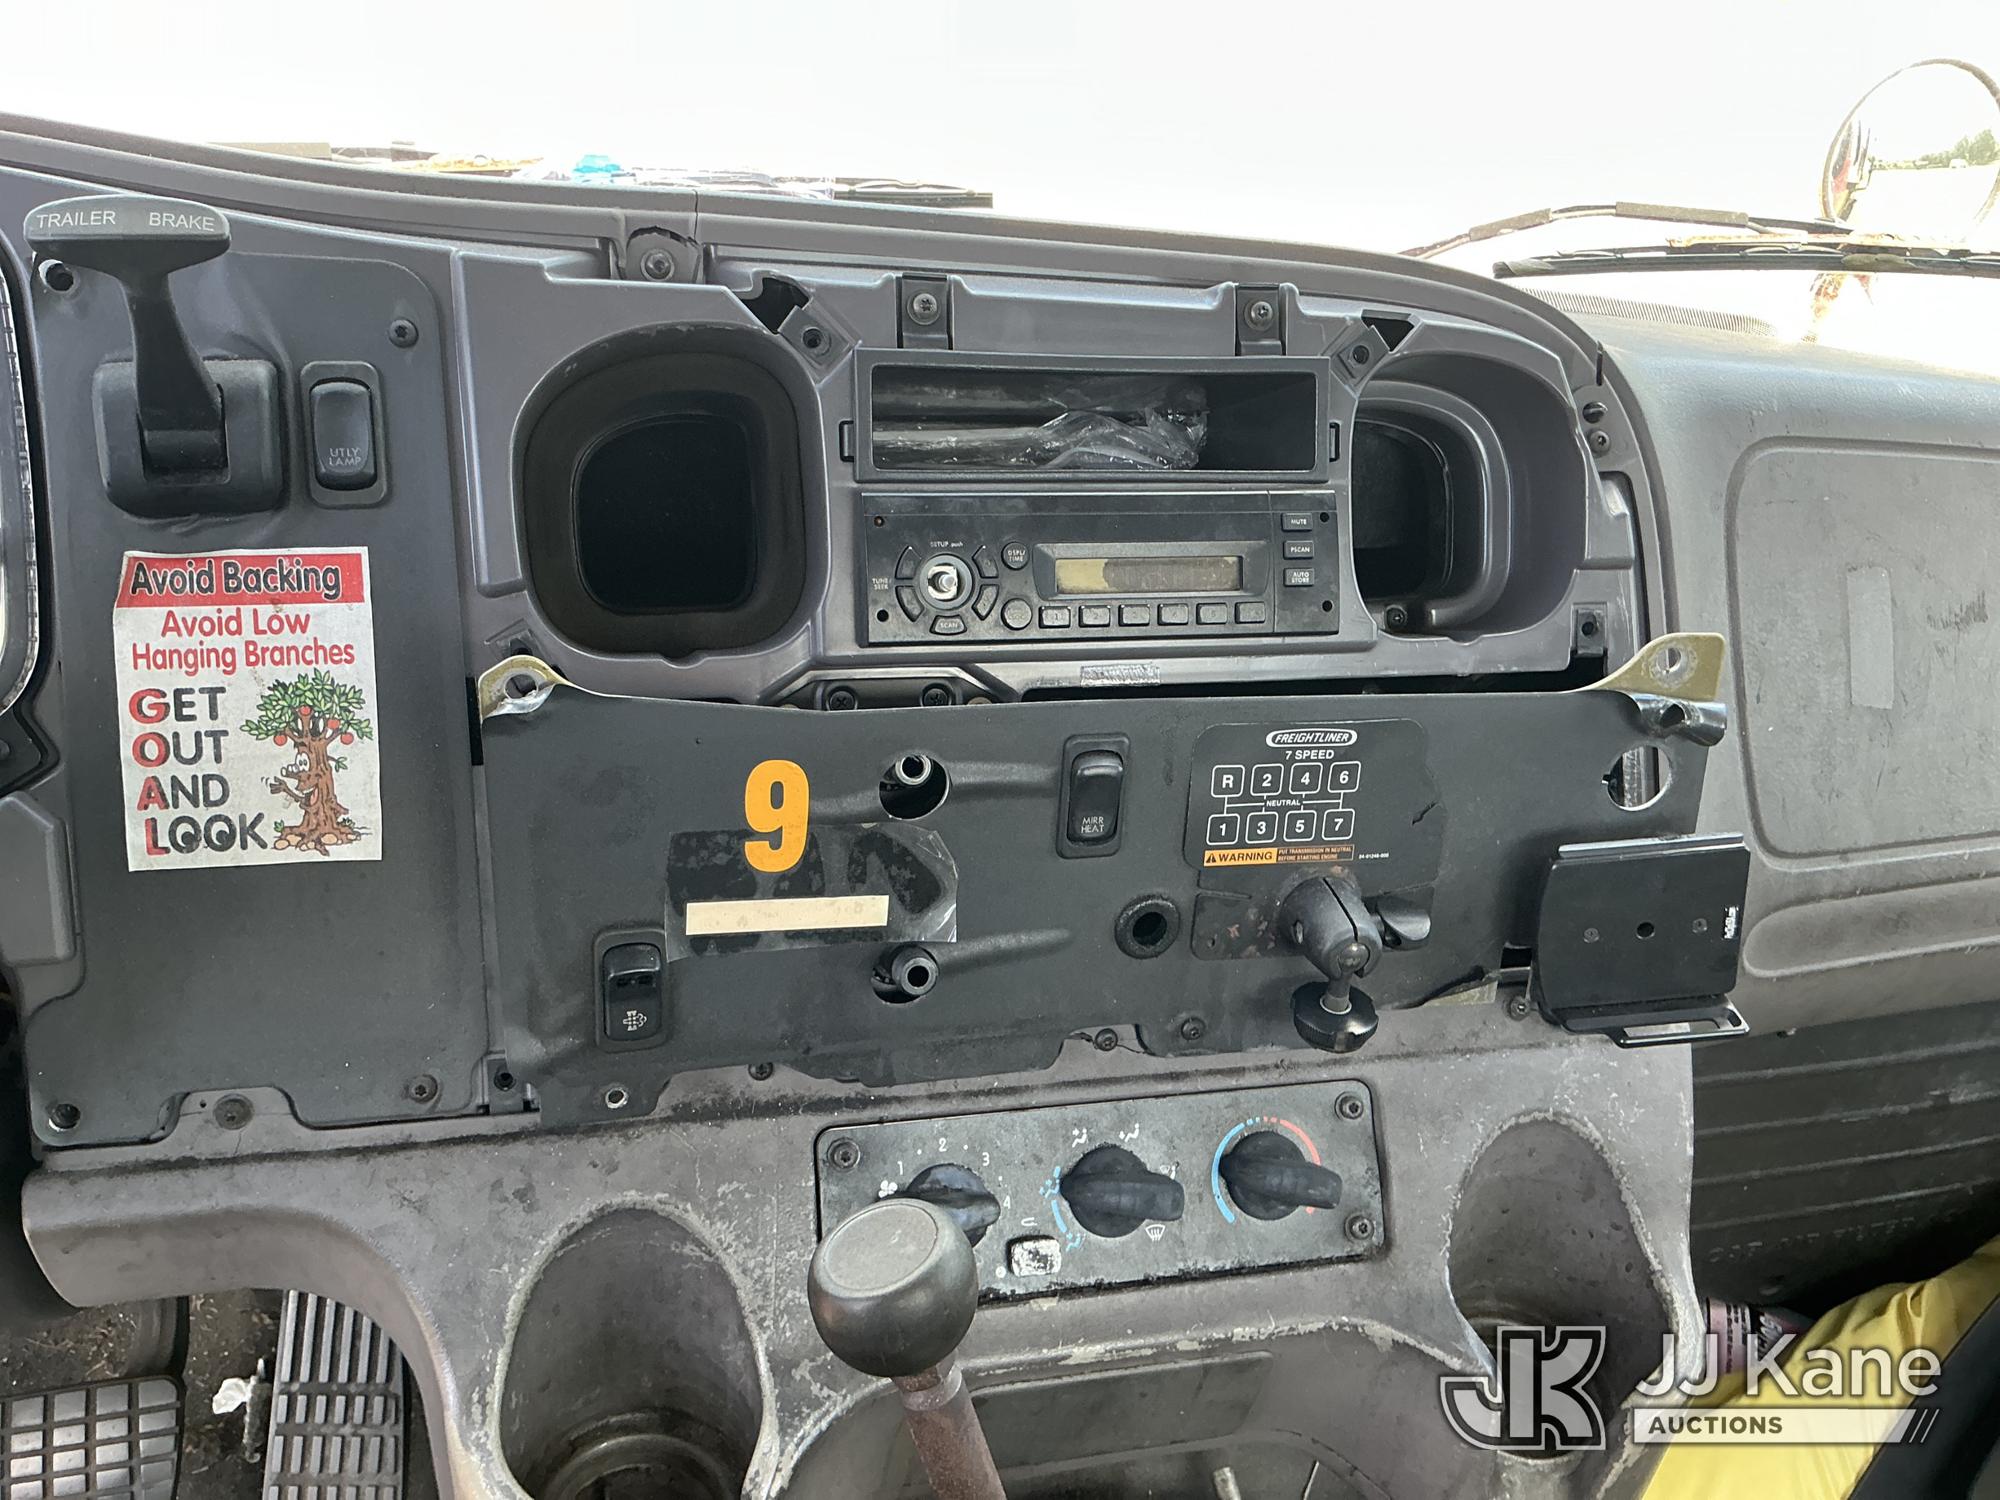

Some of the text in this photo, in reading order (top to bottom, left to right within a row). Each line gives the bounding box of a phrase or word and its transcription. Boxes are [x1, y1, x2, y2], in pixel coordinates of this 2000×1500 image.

[36, 210, 215, 232] TRAILER BRAKE
[329, 447, 361, 457] UTLY
[328, 456, 362, 467] LAMP
[130, 557, 342, 600] Avoid Backing
[161, 607, 311, 637] Avoid Low
[132, 637, 356, 677] Hanging Branches
[129, 686, 226, 724] GET
[1274, 732, 1350, 743] FREIGHTLINER
[132, 730, 229, 767] OUT
[1285, 749, 1335, 760] 7 SPEED
[1222, 771, 1349, 789] R 2 4 6
[137, 773, 230, 811] AND
[1266, 798, 1301, 807] NEUTRAL
[744, 759, 810, 873] 9
[1082, 816, 1104, 825] MIRR
[145, 812, 269, 856] LOOK
[1080, 824, 1105, 834] HEAT
[1219, 818, 1343, 836] 1 3 5 7
[1218, 851, 1273, 862] WARNING
[939, 1137, 947, 1152] 2
[982, 1152, 990, 1166] 3
[897, 1160, 904, 1175] 1
[1003, 1195, 1011, 1210] 4
